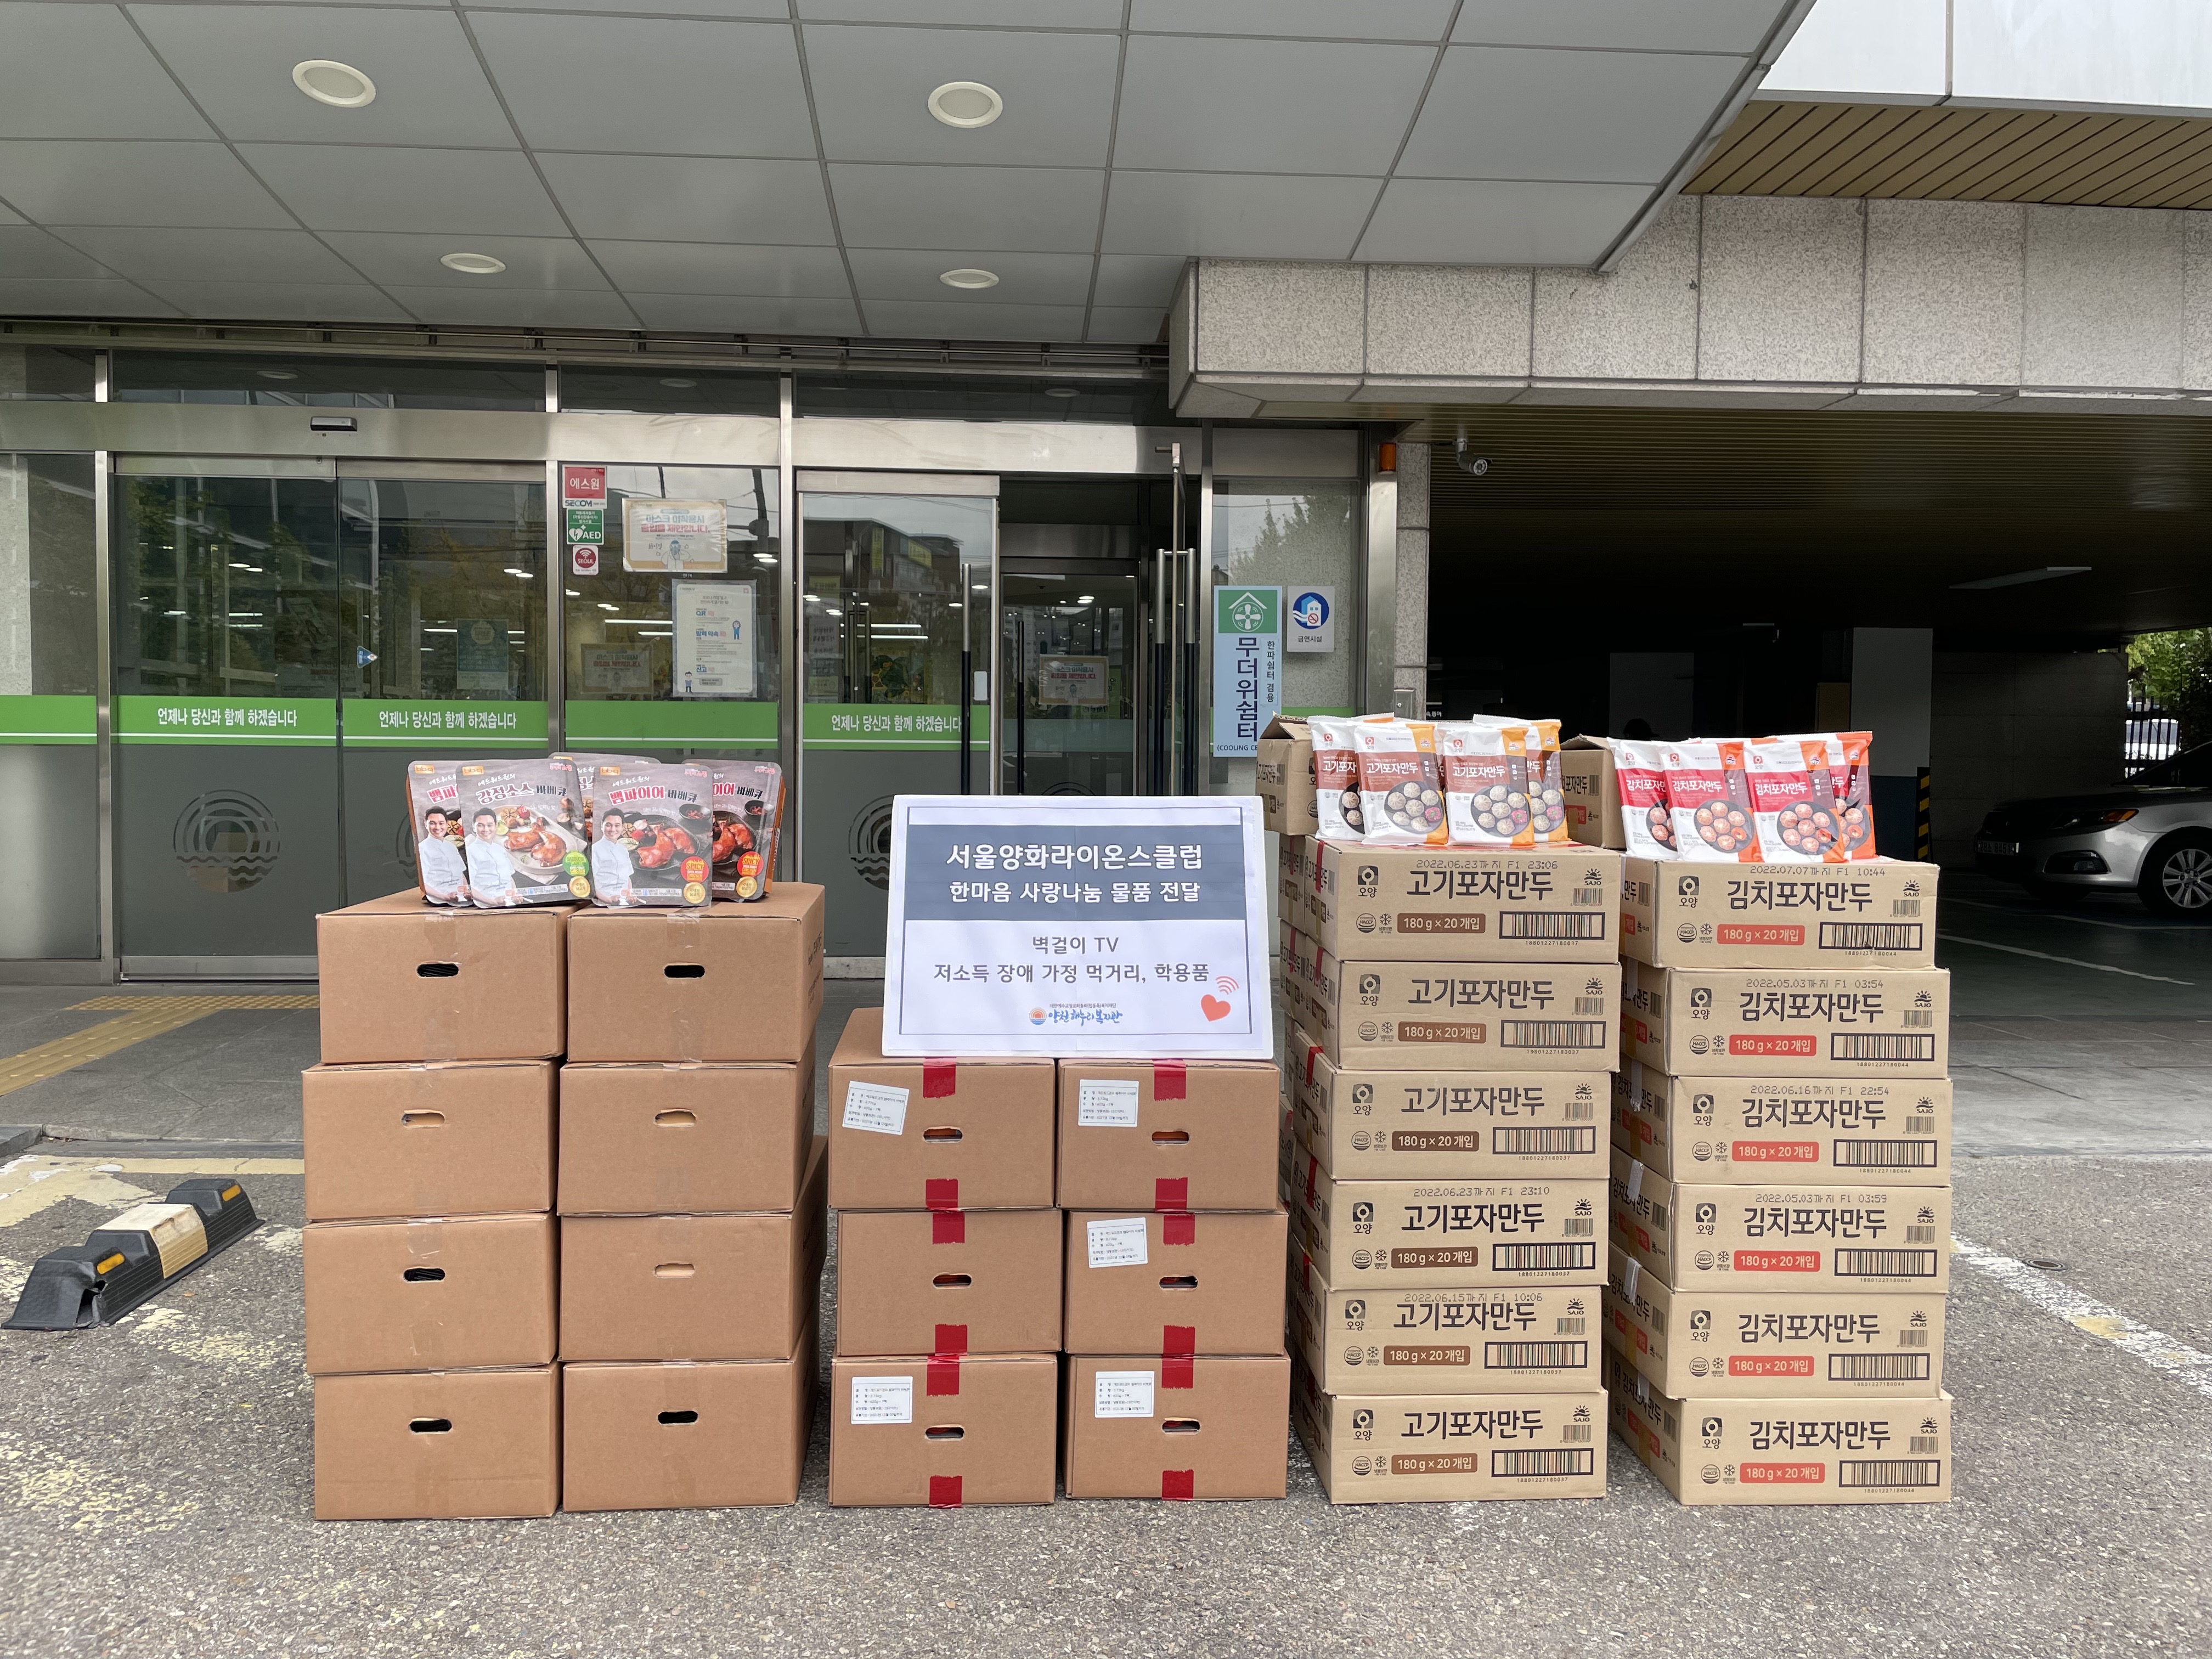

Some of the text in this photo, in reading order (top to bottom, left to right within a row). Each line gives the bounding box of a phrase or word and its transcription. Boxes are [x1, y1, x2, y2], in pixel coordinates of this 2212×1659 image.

[570, 478, 599, 489] 에스원
[1267, 640, 1275, 702] 한파쉼터 겸용
[1235, 637, 1259, 742] 무더위쉼터
[157, 708, 297, 727] 언제나 당신과 함께 하겠습니다
[379, 711, 517, 730] 언제나 당신과 함께 하겠습니다
[831, 715, 961, 733] 언제나 당신과 함께 하겠습니다
[1323, 761, 1356, 773] 고기포자
[1366, 763, 1418, 774] 고기포자만두
[1453, 765, 1505, 778] 고기포자만두
[713, 782, 763, 799] 이어 바베큐
[1626, 780, 1666, 792] 김치포자만
[1672, 781, 1723, 792] 김치포자만두
[1755, 782, 1808, 795] 김치포자만두
[427, 785, 458, 803] 뱀파
[476, 782, 568, 804] 강정소스 바베큐
[608, 786, 698, 805] 뱀파이어 바베큐
[946, 844, 1203, 871] 서울양화라이온스클럽
[1508, 860, 1520, 869] F1
[1528, 860, 1558, 869] 23:06
[1837, 867, 1849, 876] F1
[1857, 867, 1886, 876] 10:44
[1406, 870, 1554, 901] 고기포자만두
[949, 881, 1201, 904] 한마음 사랑나눔 물품 전달
[1358, 887, 1377, 898] 오양
[1727, 880, 1873, 912] 김치포자만두
[1679, 896, 1698, 908] 오양
[1460, 917, 1480, 930] 개입
[1779, 929, 1799, 942] 개입
[1032, 935, 1119, 955] 벽걸이 TV
[934, 963, 1209, 983] 저소득 장애 가정 먹거리, 학용품
[1835, 979, 1847, 989] F1
[1854, 980, 1883, 989] 03:54
[1408, 979, 1555, 1010] 고기포자만두
[1691, 1008, 1710, 1019] 오양
[1739, 992, 1884, 1023] 김치포자만두
[1048, 1009, 1069, 1023] 양천
[1096, 1009, 1123, 1024] 복지관
[1840, 1086, 1852, 1095] F1
[1861, 1086, 1889, 1095] 22:54
[1401, 1087, 1545, 1116] 고기포자만두
[1353, 1105, 1372, 1116] 오양
[1741, 1098, 1887, 1130] 김치포자만두
[1694, 1115, 1712, 1126] 오양
[1793, 1146, 1813, 1159] 개입
[1501, 1187, 1513, 1196] F1
[1521, 1187, 1550, 1196] 23:10
[1841, 1194, 1851, 1203] F1
[1858, 1194, 1887, 1203] 03:59
[1401, 1204, 1545, 1233] 고기포자만두
[1743, 1207, 1887, 1238] 김치포자만두
[1353, 1223, 1373, 1234] 오양
[1696, 1224, 1715, 1235] 오양
[1493, 1293, 1505, 1302] F1
[1514, 1293, 1542, 1302] 10:06
[1393, 1302, 1537, 1331] 고기포자만두
[1346, 1321, 1365, 1331] 오양
[1738, 1313, 1881, 1344] 김치포자만두
[1691, 1330, 1709, 1342] 오양
[1401, 1410, 1544, 1440] 고기포자만두
[1749, 1420, 1891, 1451] 김치포자만두
[1702, 1437, 1721, 1448] 오양
[1452, 1457, 1472, 1470] 개입
